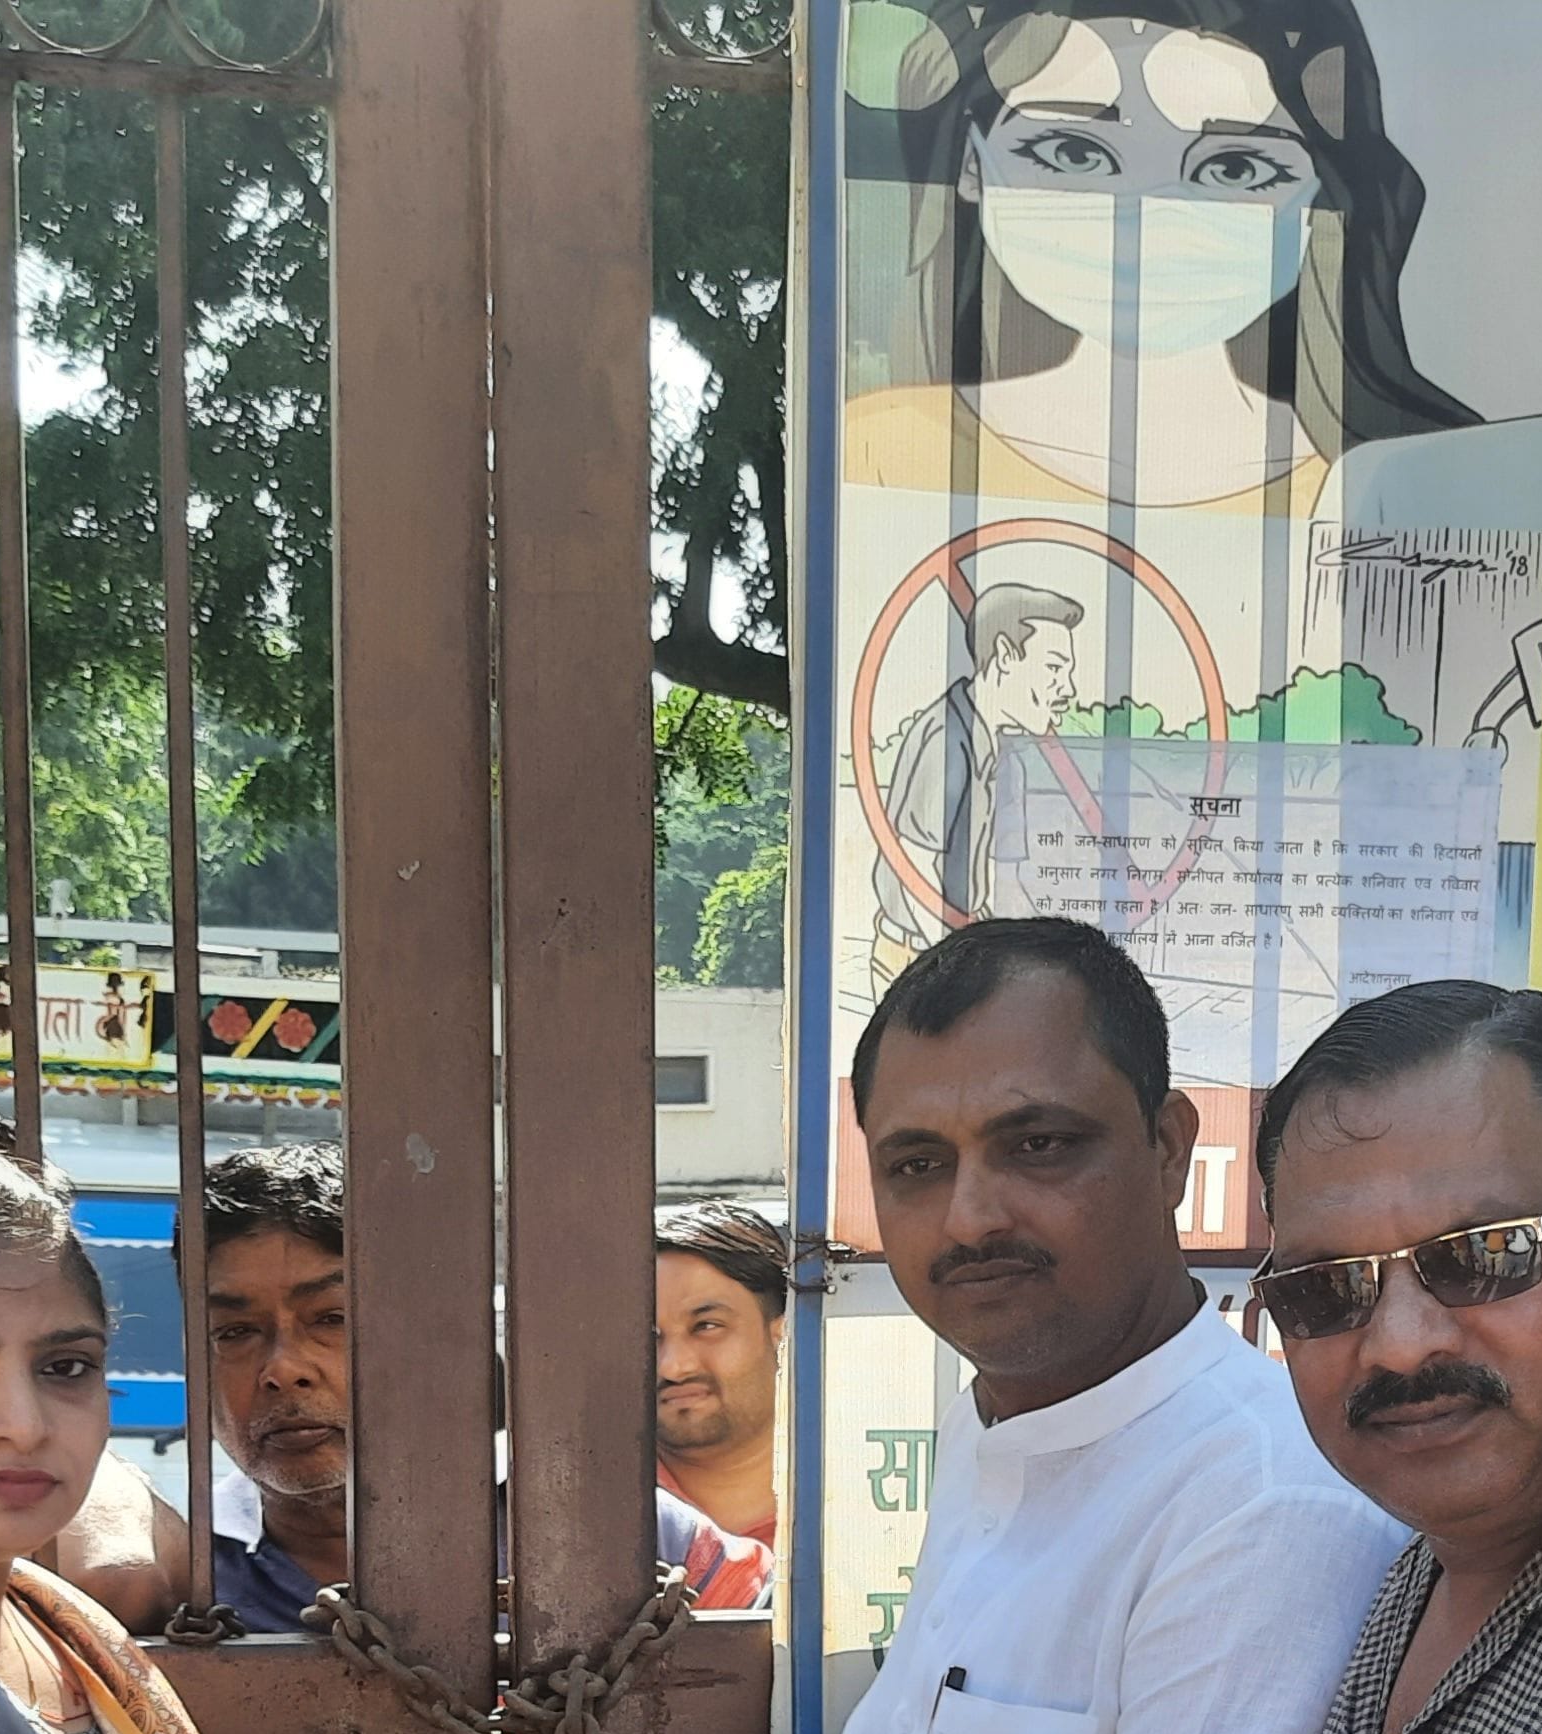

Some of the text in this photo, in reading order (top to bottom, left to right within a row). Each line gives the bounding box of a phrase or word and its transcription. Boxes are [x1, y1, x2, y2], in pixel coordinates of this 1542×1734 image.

[1189, 796, 1242, 822] सूचना
[1037, 833, 1064, 848] सभी
[1161, 834, 1177, 851] को
[1187, 834, 1224, 857] सूचित
[1233, 836, 1265, 852] किया
[1274, 840, 1303, 856] जाता
[1313, 839, 1323, 857] है
[1331, 839, 1348, 856] कि
[1359, 843, 1399, 858] सरकार
[1409, 843, 1423, 859] की
[1037, 866, 1082, 886] अनुसार
[1090, 867, 1118, 881] नगर
[1177, 867, 1224, 884] सोनीपत
[1232, 868, 1283, 885] कार्यालय
[1291, 873, 1308, 887] का
[1315, 872, 1353, 888] प्रत्येक
[1362, 872, 1406, 889] शनिवार
[1441, 875, 1481, 892] रविवार
[1036, 894, 1052, 911] को
[1059, 899, 1106, 913] अवकाश
[1114, 900, 1143, 914] रहता
[1150, 898, 1160, 915] है
[1299, 903, 1324, 919] सभी
[1387, 907, 1403, 921] का
[1410, 905, 1454, 923] शनिवार
[1184, 933, 1215, 946] आना
